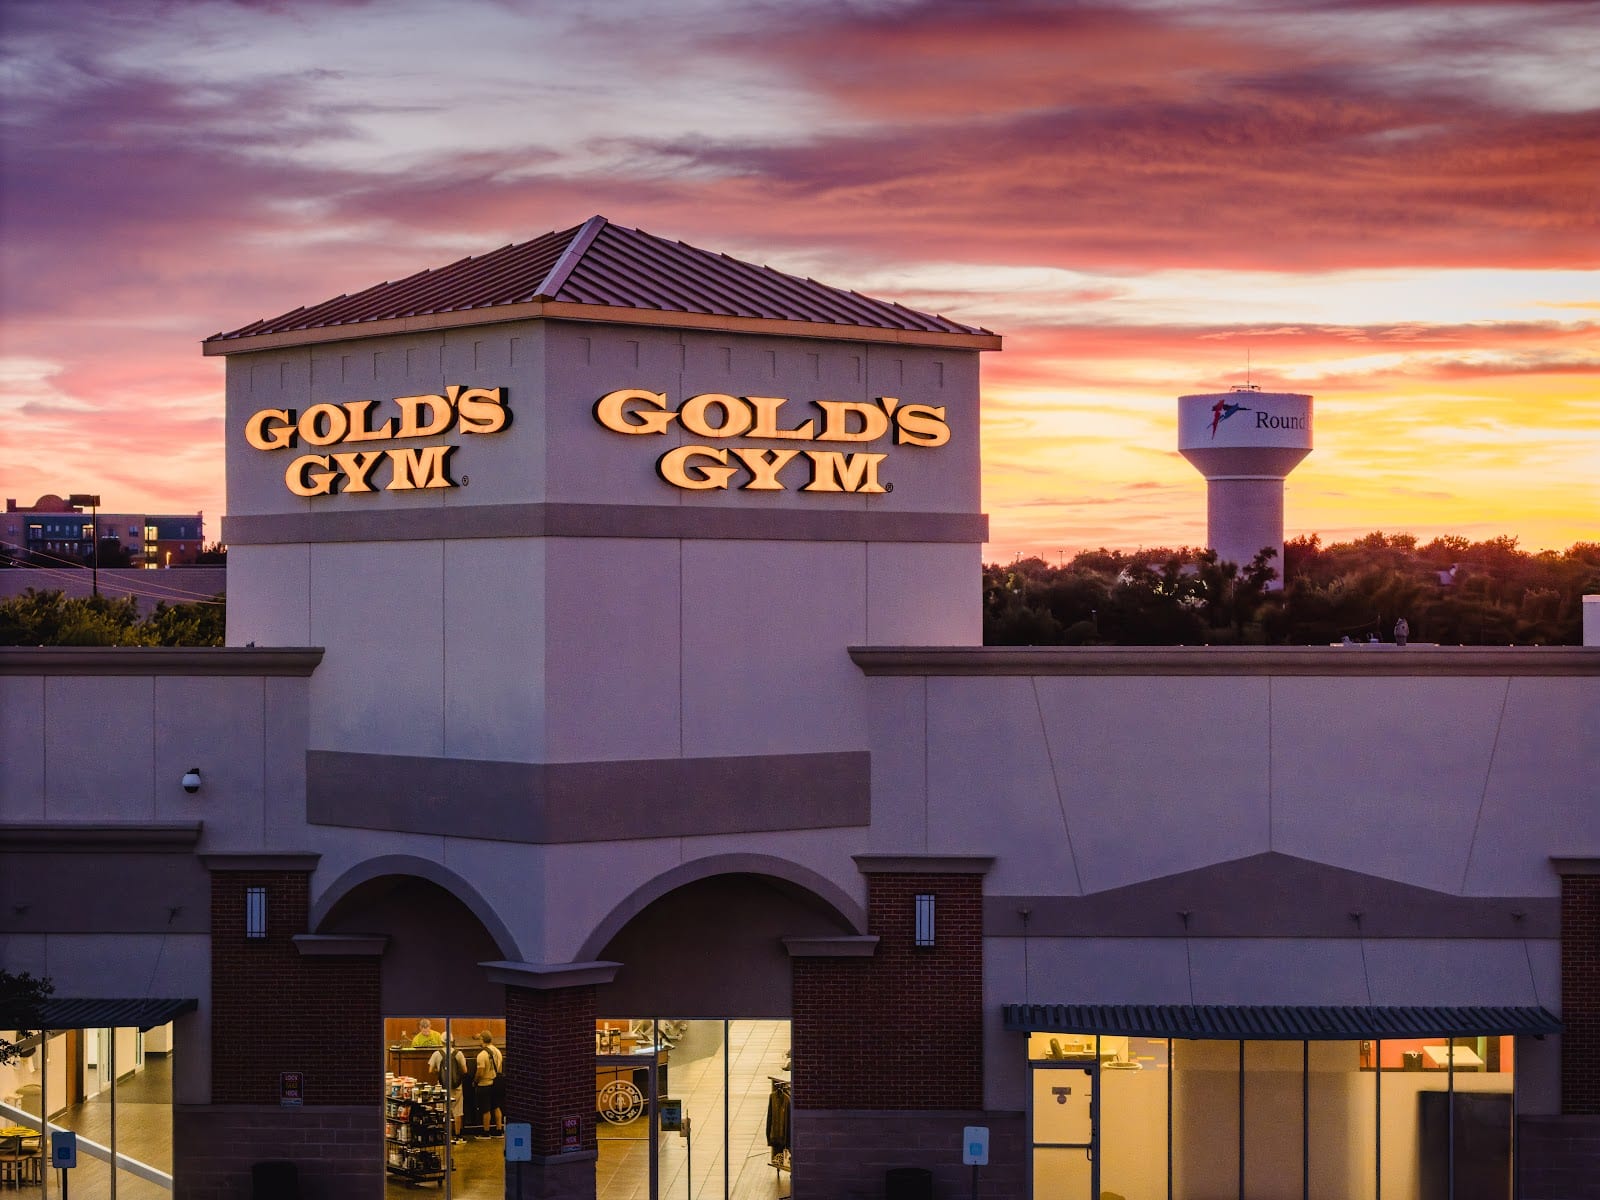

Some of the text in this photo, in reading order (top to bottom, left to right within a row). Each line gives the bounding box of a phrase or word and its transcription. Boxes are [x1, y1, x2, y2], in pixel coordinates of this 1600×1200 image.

[244, 385, 512, 450] GOLD'S
[593, 389, 951, 447] GOLD'S
[1255, 411, 1305, 429] Round
[602, 1083, 639, 1104] GOLD'S
[605, 1108, 638, 1122] GYM
